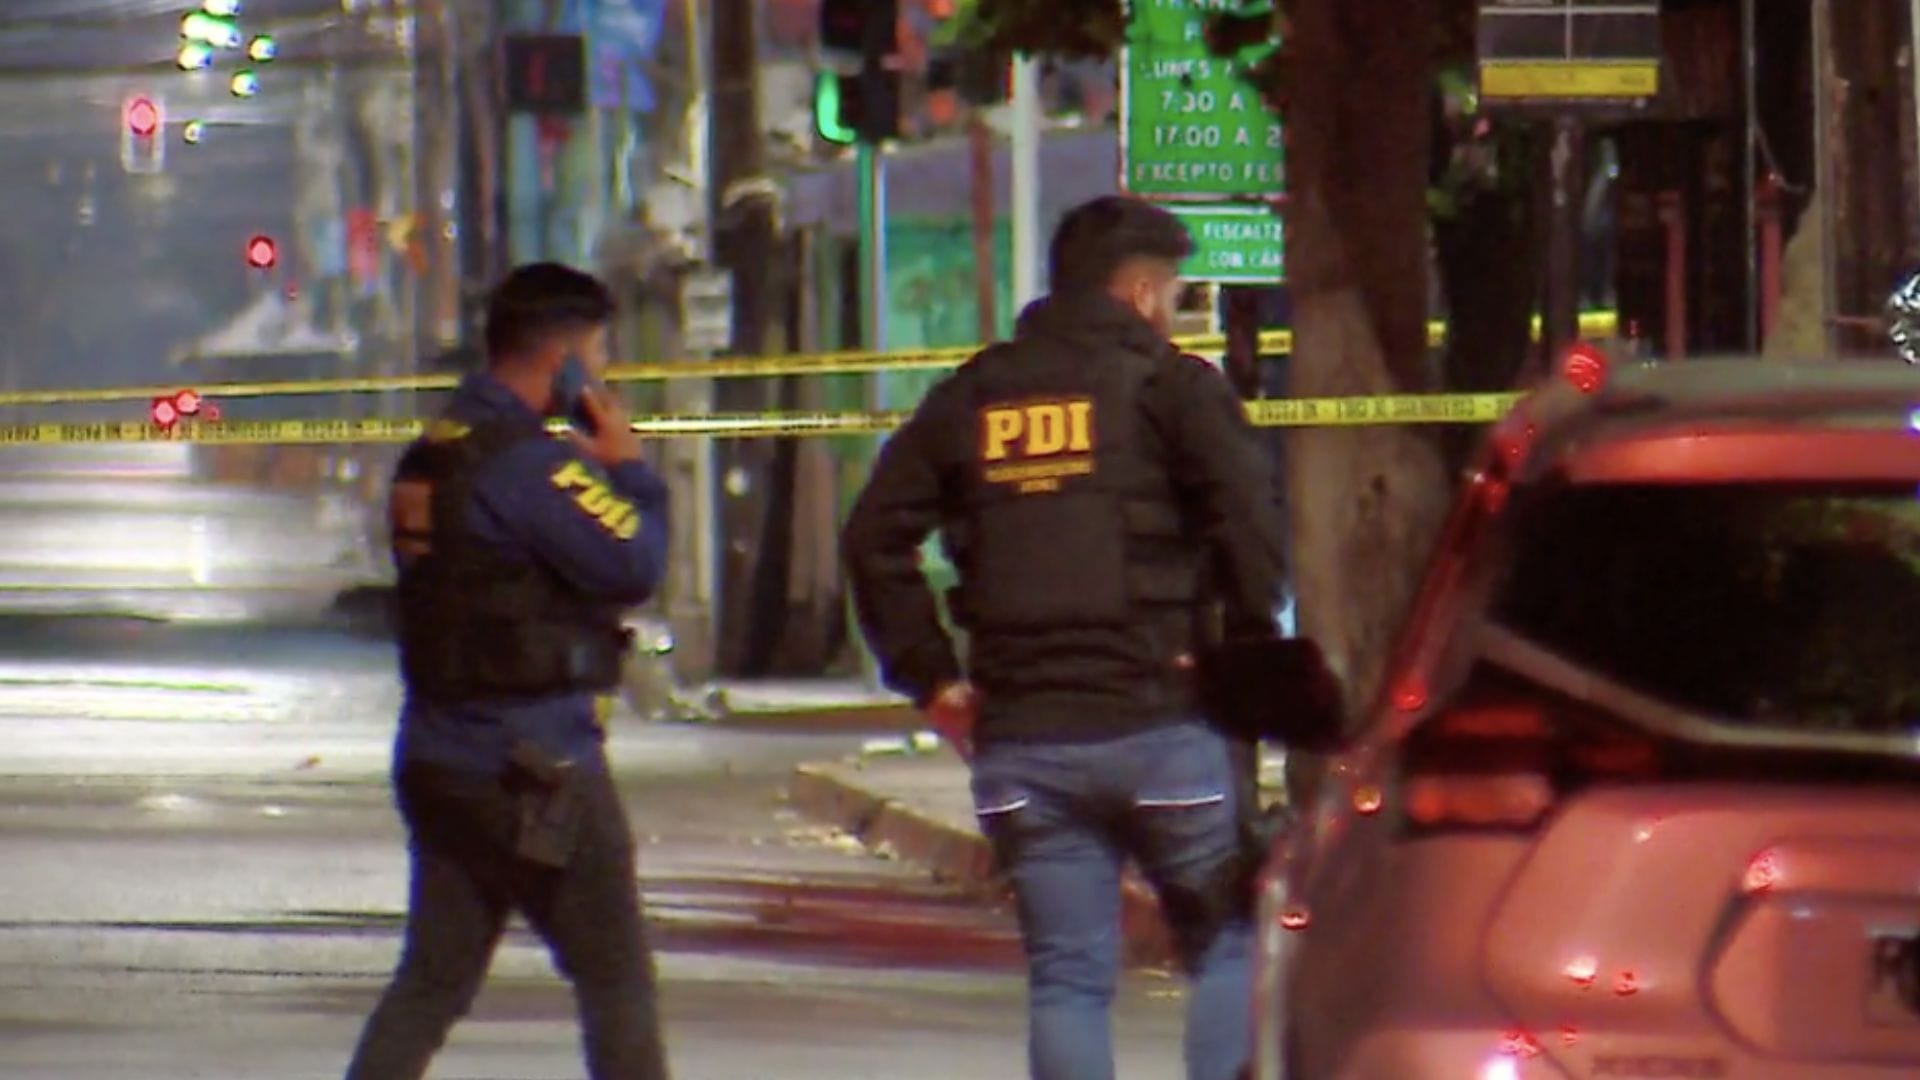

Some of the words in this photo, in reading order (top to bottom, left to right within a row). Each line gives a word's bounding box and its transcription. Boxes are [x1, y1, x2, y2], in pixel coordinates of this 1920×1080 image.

[1135, 162, 1233, 182] EXCEPTO
[984, 401, 1092, 459] PDI
[551, 460, 640, 540] PDI
